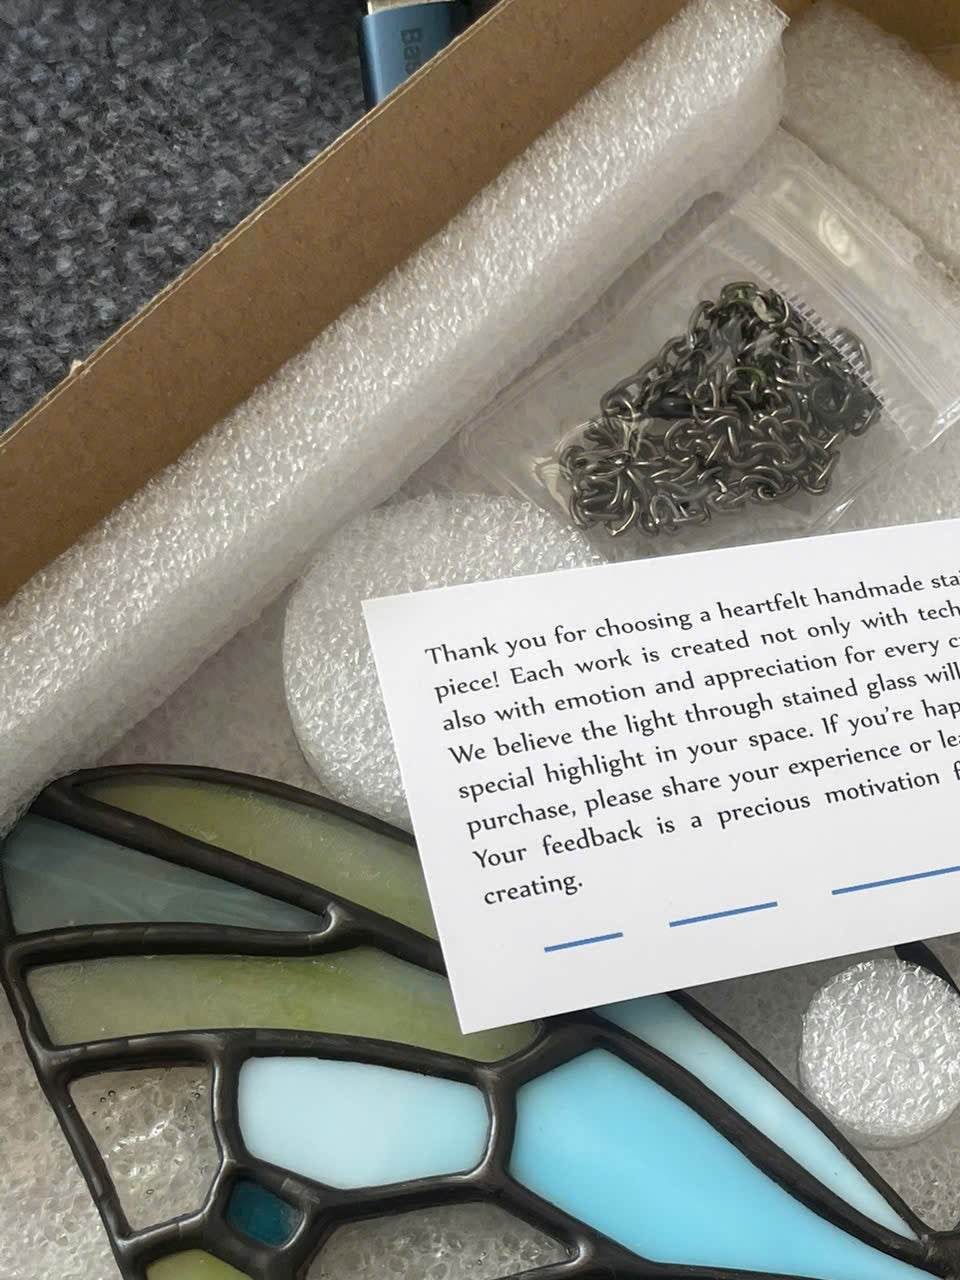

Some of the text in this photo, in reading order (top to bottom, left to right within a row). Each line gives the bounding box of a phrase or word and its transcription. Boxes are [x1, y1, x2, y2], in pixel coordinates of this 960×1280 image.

[424, 636, 499, 665] Thank
[505, 635, 547, 658] you
[554, 624, 587, 645] for
[595, 612, 693, 638] choosing
[700, 610, 711, 623] a
[716, 590, 809, 619] heartfelt
[813, 575, 924, 605] handmade
[434, 671, 500, 704] piece!
[509, 659, 564, 685] Each
[574, 648, 633, 673] work
[641, 647, 660, 664] is
[671, 629, 750, 659] created
[760, 627, 798, 645] not
[807, 616, 851, 639] only
[861, 607, 908, 629] with
[443, 709, 486, 731] also
[494, 696, 545, 721] with
[554, 685, 646, 711] emotion
[655, 670, 695, 695] and
[704, 655, 837, 691] appreciation
[844, 645, 876, 665] for
[884, 639, 939, 658] every
[448, 744, 487, 764] We
[493, 732, 573, 756] believe
[581, 719, 618, 741] the
[623, 709, 677, 737] light
[685, 692, 773, 723] through
[782, 677, 858, 708] stained
[866, 673, 918, 700] glass
[458, 766, 535, 803] special
[543, 749, 646, 785] highlight
[655, 745, 678, 763] in
[686, 738, 738, 764] your
[748, 726, 814, 751] space.
[821, 713, 839, 735] If
[466, 803, 576, 840] purchase,
[584, 788, 654, 818] please
[661, 775, 722, 798] share
[728, 766, 779, 792] your
[788, 745, 902, 777] experience
[909, 739, 932, 754] or
[472, 847, 527, 868] Your
[542, 819, 643, 856] feedback
[656, 816, 676, 834] is
[691, 815, 702, 829] a
[717, 795, 811, 830] precious
[824, 772, 940, 804] motivation
[484, 875, 583, 905] creating.
